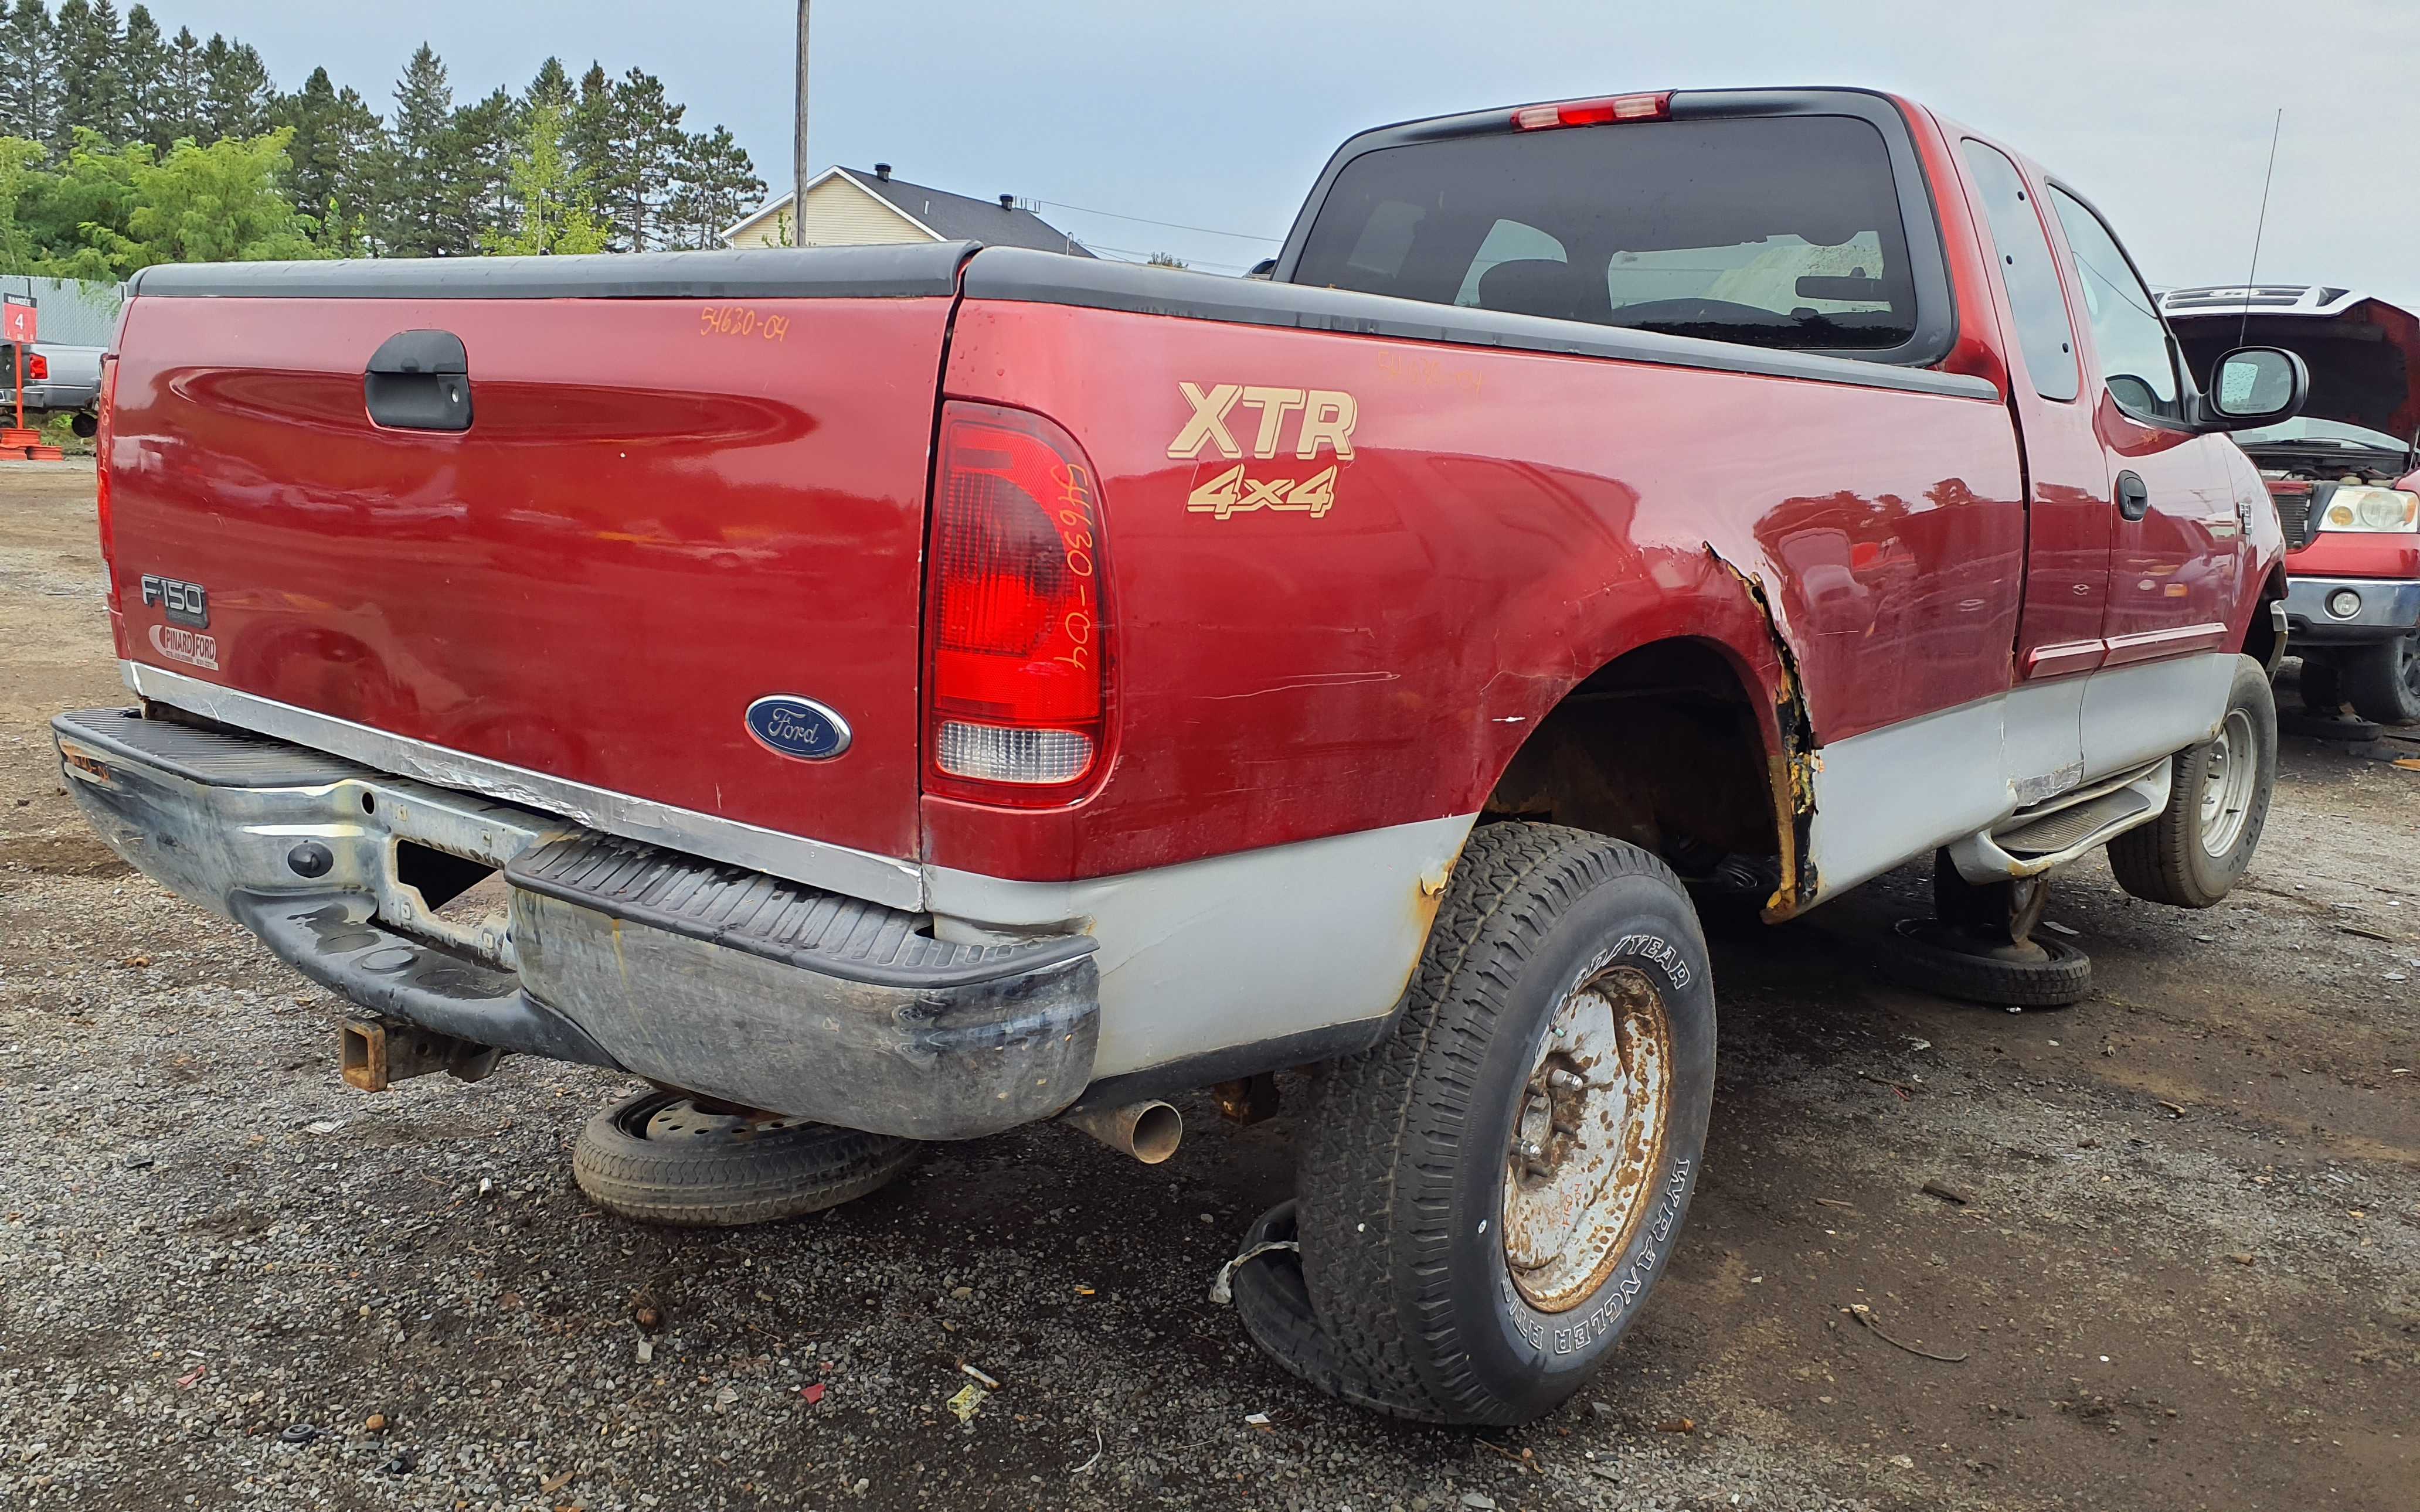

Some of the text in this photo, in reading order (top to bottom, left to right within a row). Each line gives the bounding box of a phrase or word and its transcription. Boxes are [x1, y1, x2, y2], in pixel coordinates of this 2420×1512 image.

[15, 313, 24, 330] 4
[700, 305, 790, 342] 54630-04
[1166, 381, 1358, 460] XTR
[1051, 463, 1093, 671] 54630-04
[166, 628, 192, 655] PINARD
[196, 636, 215, 660] FORD
[768, 707, 819, 744] Ford
[1554, 1158, 1691, 1355] WRANGLER
